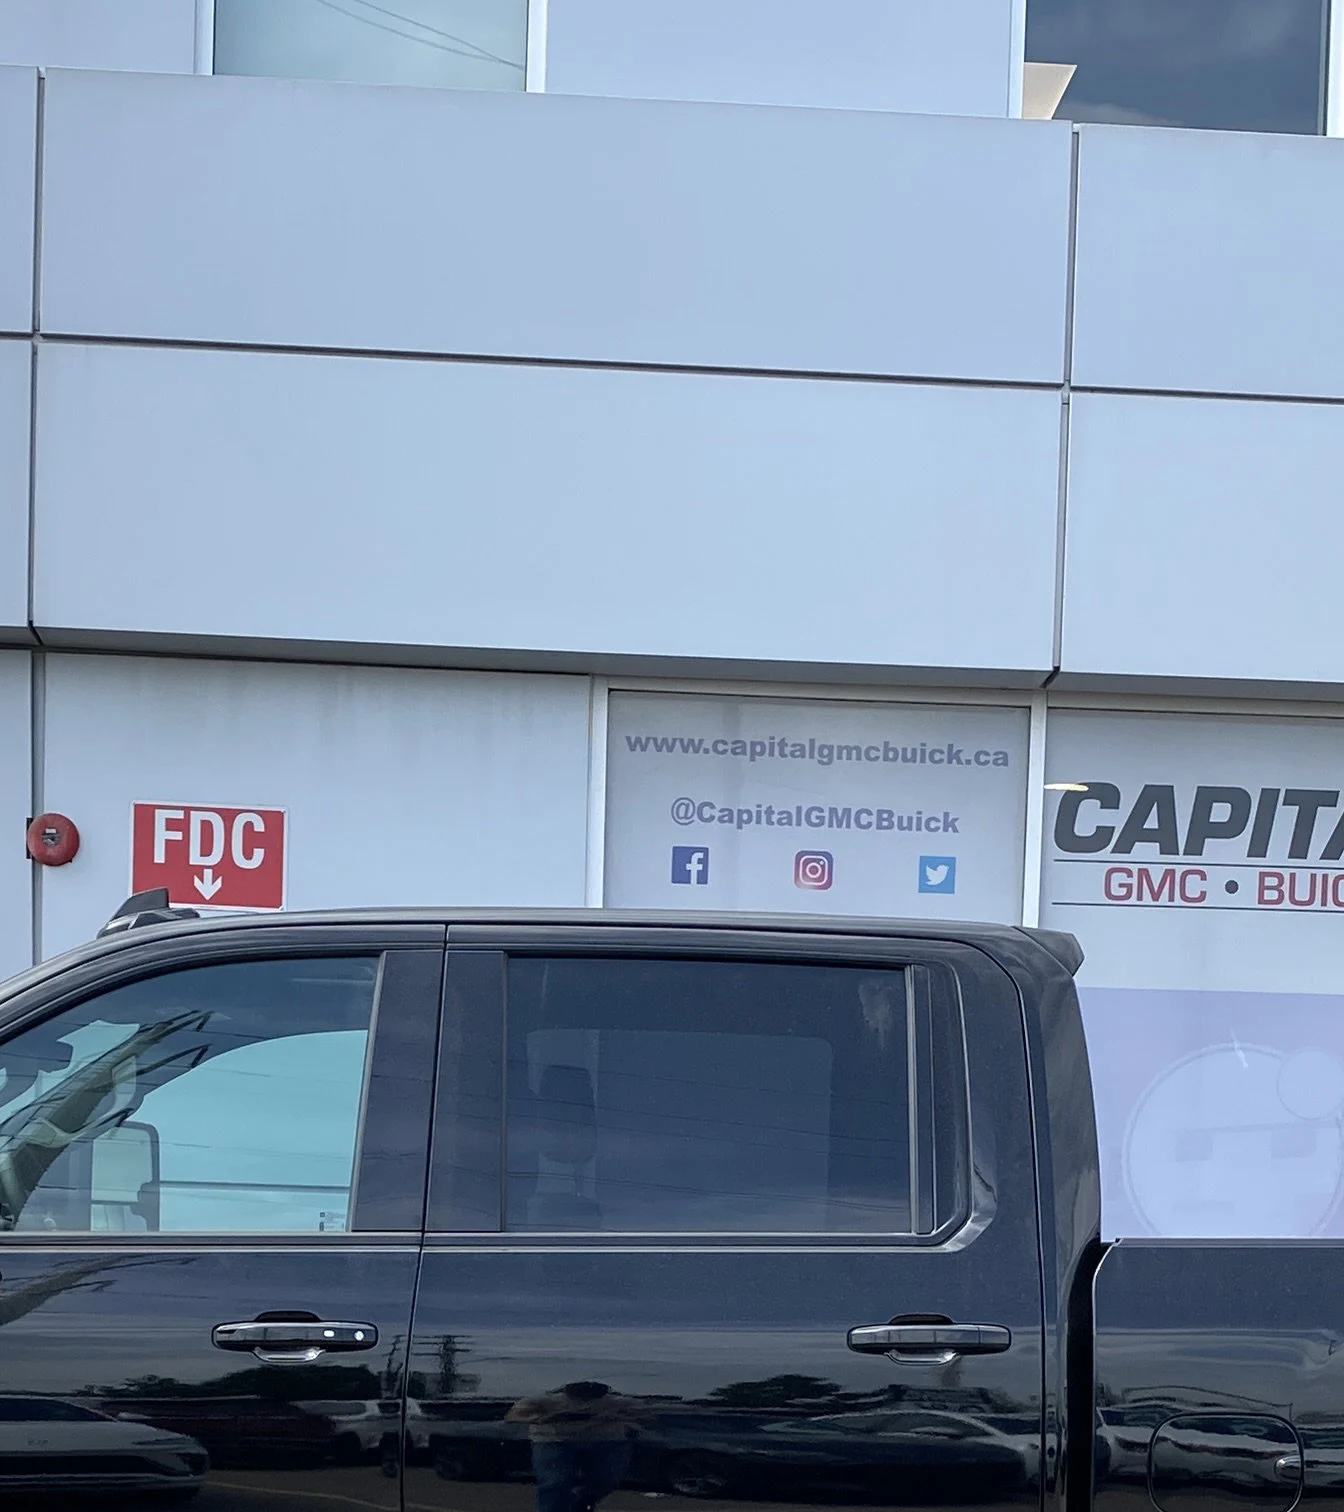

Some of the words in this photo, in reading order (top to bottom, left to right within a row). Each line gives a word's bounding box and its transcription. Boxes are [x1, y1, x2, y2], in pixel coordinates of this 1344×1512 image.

[624, 732, 1010, 769] www.capitalgmcbuick.ca
[670, 796, 960, 835] @CapitalGMCBuick
[153, 808, 266, 870] FDC
[1104, 867, 1208, 904] GMC
